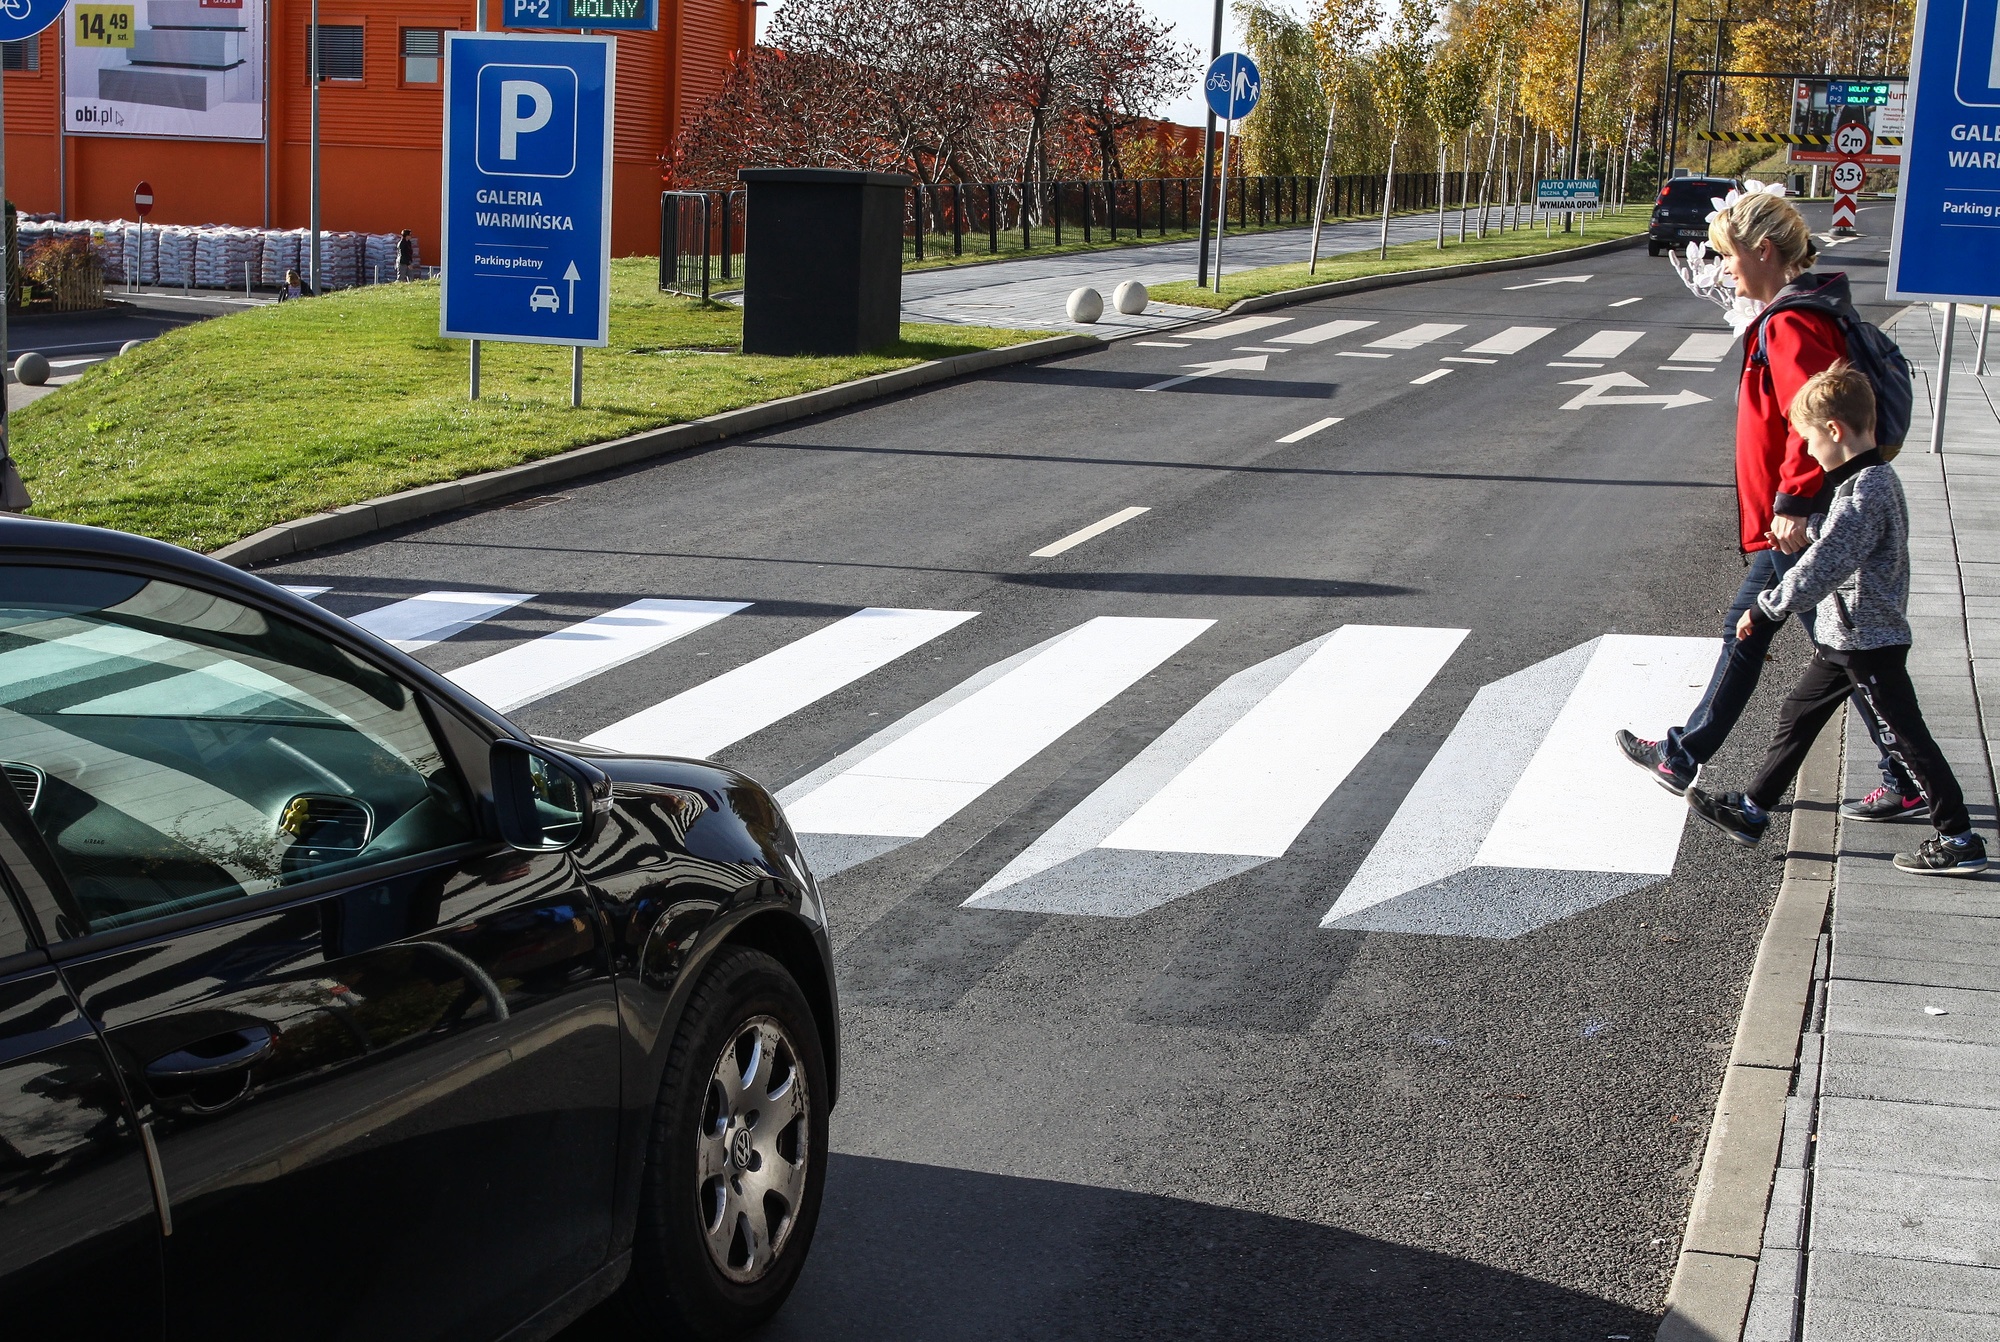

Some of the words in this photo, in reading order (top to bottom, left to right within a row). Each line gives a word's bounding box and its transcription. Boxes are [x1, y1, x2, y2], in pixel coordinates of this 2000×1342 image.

[514, 0, 549, 18] P+2
[574, 0, 638, 17] WOLNY
[1848, 85, 1870, 93] WOLNY
[1829, 95, 1842, 103] P+2
[75, 106, 113, 126] obi.pl
[499, 80, 553, 160] P
[1840, 134, 1863, 147] 2m
[476, 189, 543, 206] GALERIA
[1540, 201, 1575, 209] WYMIANA
[1577, 201, 1597, 209] OPON
[1943, 202, 1992, 217] Parking
[475, 211, 574, 231] WARMIŃSKA
[474, 255, 511, 268] Parking
[512, 256, 543, 270] płatny
